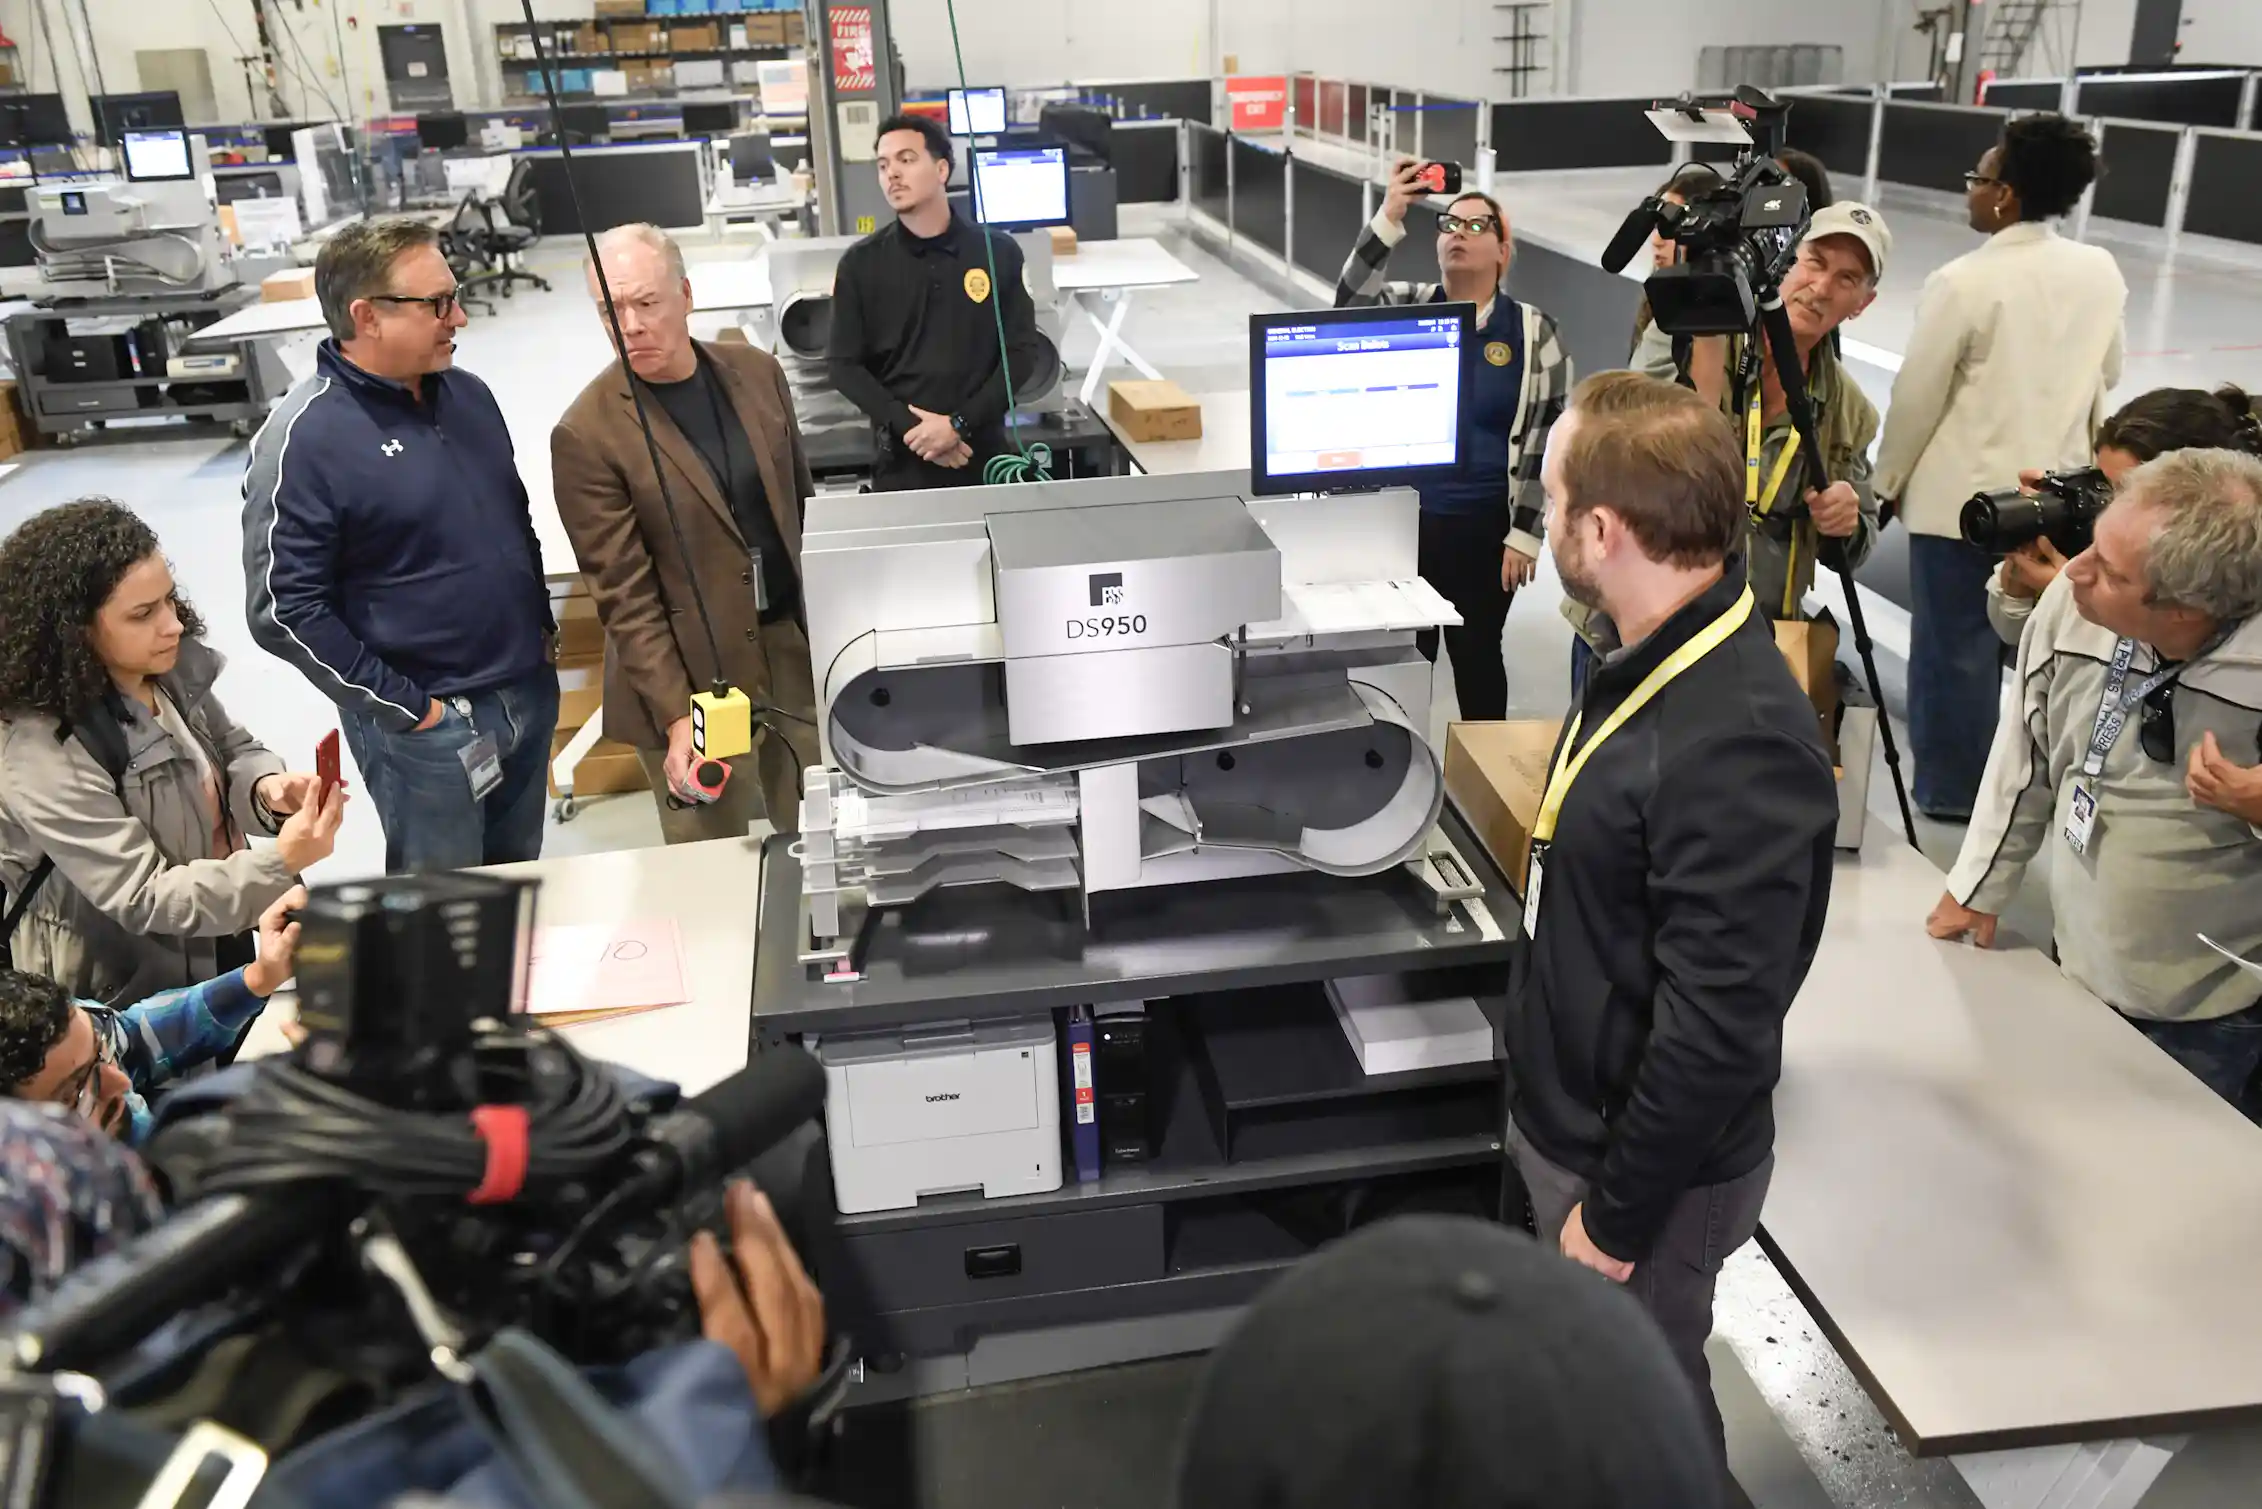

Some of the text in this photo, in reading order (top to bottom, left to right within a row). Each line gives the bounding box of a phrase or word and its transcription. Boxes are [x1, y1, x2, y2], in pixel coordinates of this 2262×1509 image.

[1066, 614, 1147, 639] DS950
[2095, 717, 2121, 752] PRESS
[925, 1093, 960, 1103] brother
